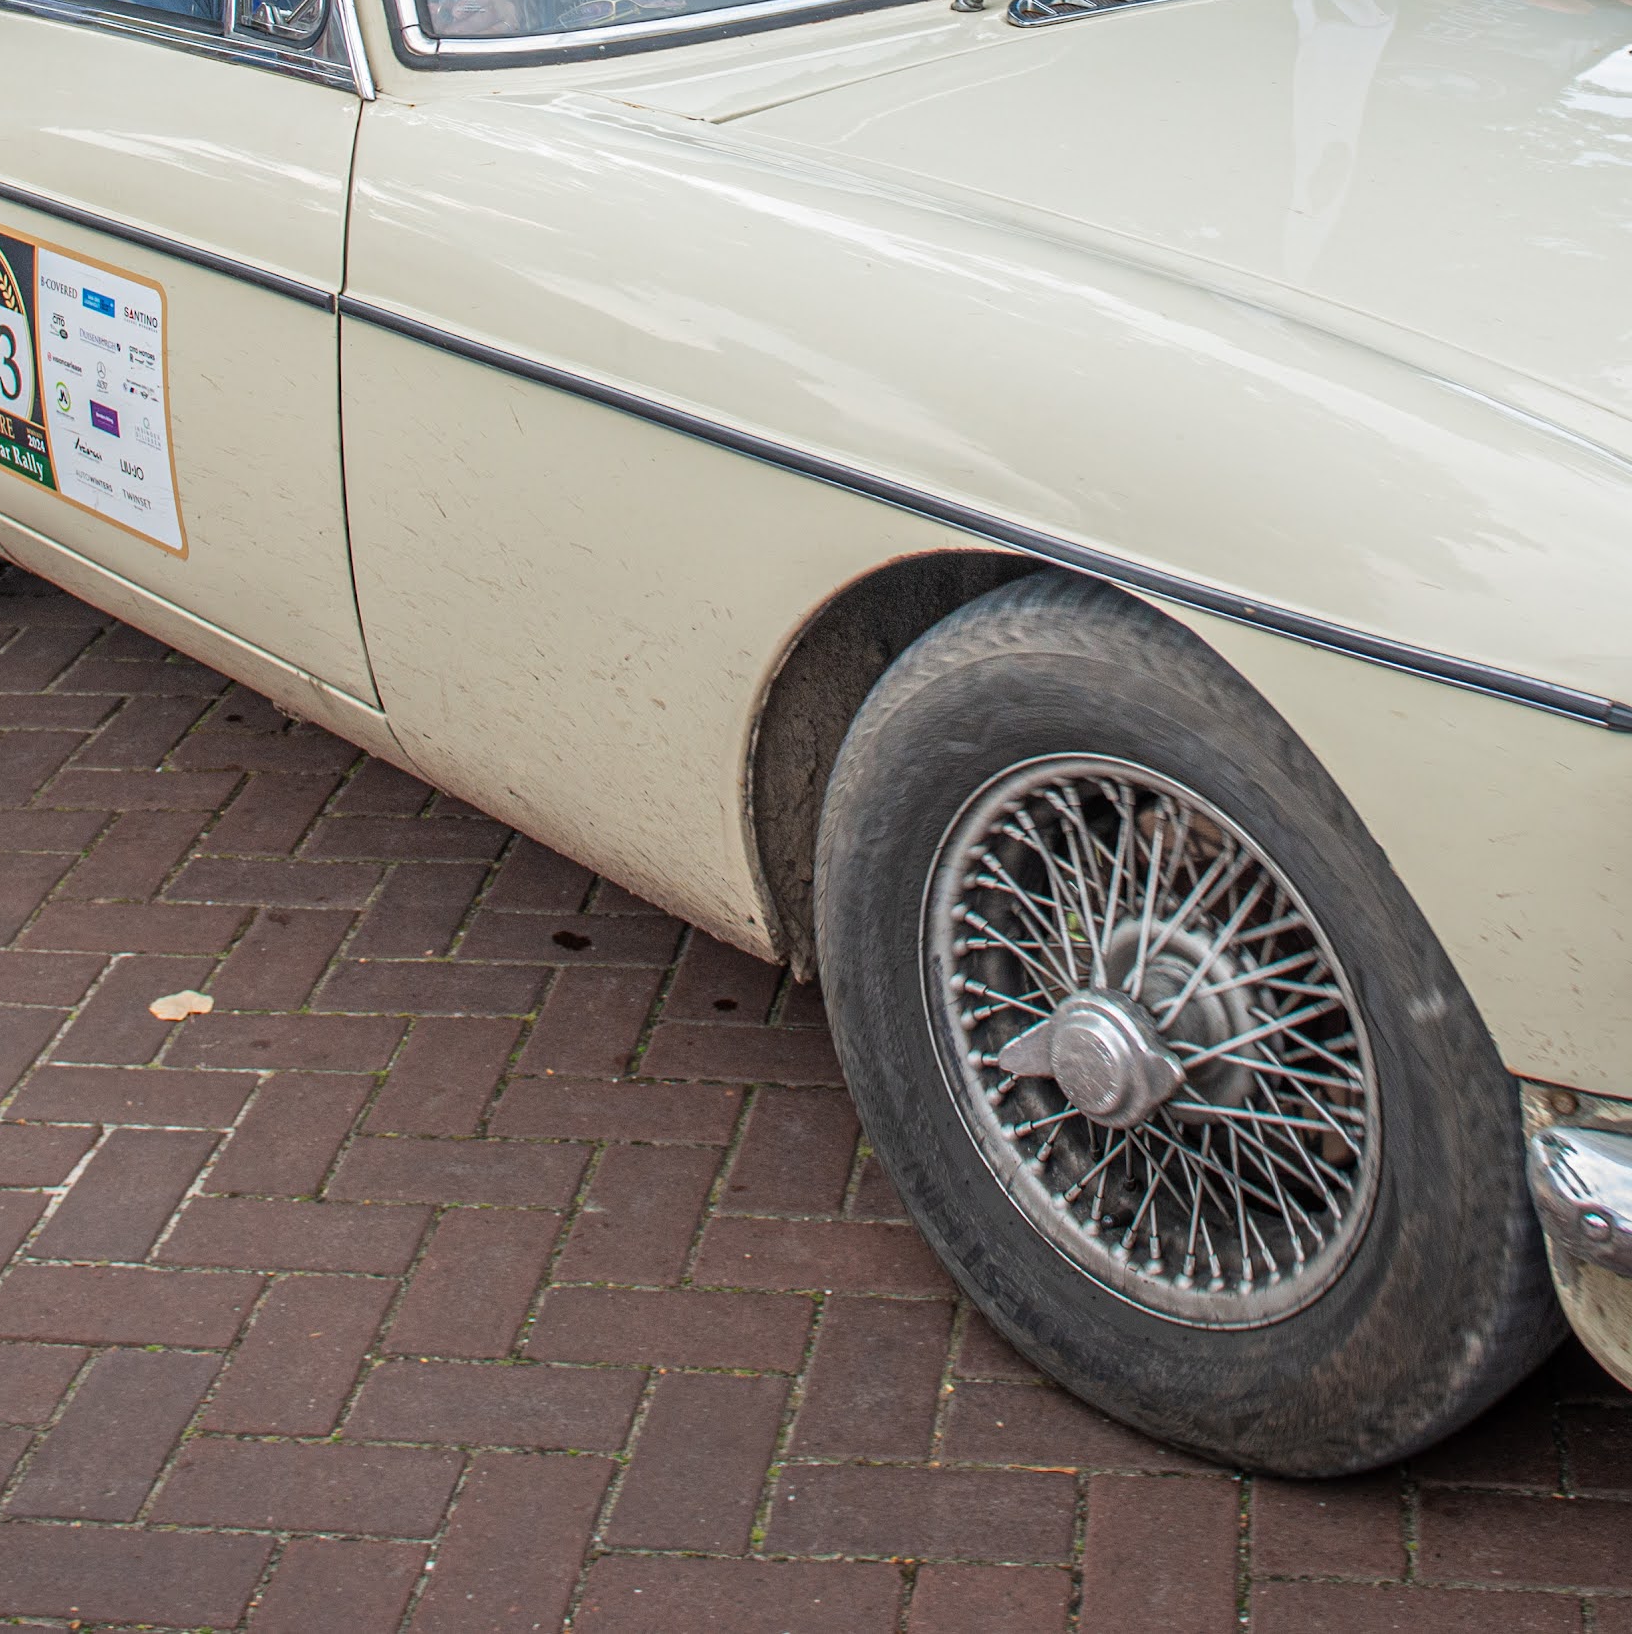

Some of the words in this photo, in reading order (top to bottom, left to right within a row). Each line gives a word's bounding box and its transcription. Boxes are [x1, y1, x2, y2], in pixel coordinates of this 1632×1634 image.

[52, 316, 66, 328] CITO
[124, 306, 159, 329] SANTINO
[27, 433, 46, 453] 2024
[11, 445, 44, 482] Rally
[122, 488, 152, 511] TWINSET
